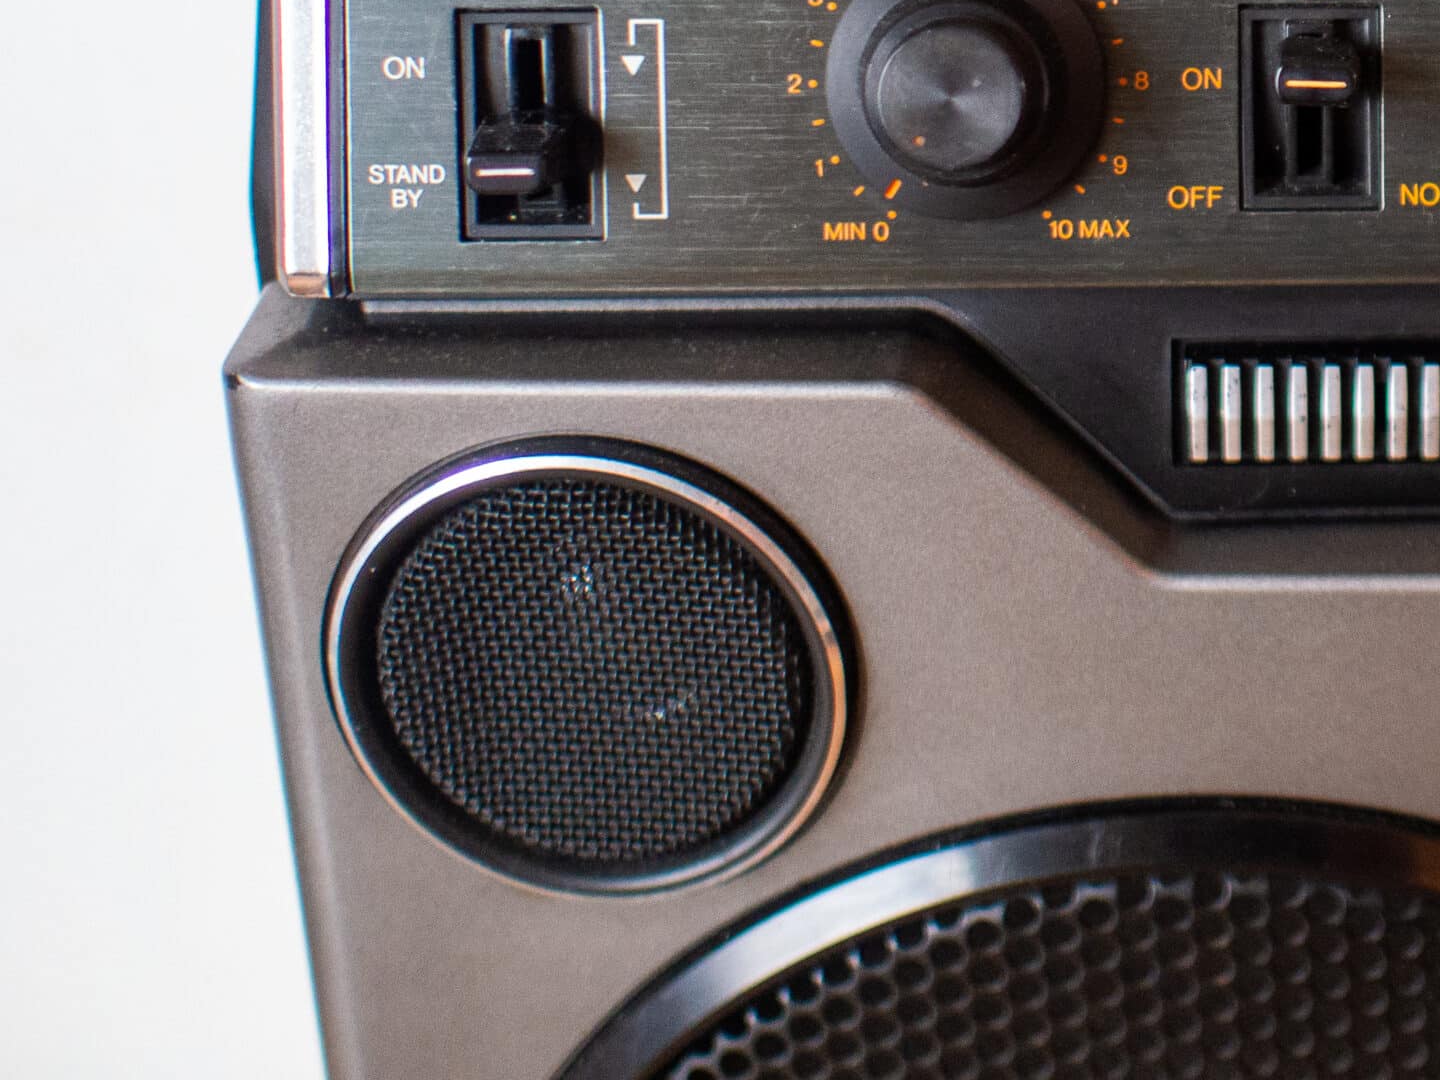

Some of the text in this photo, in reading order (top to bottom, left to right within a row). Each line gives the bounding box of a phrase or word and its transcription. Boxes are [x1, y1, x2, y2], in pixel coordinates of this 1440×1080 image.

[381, 55, 426, 80] ON
[786, 73, 803, 95] 2
[1134, 70, 1150, 91] 8
[1181, 67, 1223, 91] ON
[367, 163, 446, 187] STAND
[1112, 155, 1128, 176] 9
[390, 188, 424, 209] BY
[1167, 185, 1224, 210] OFF
[822, 221, 867, 241] MIN
[1048, 219, 1131, 241] 10 MAX
